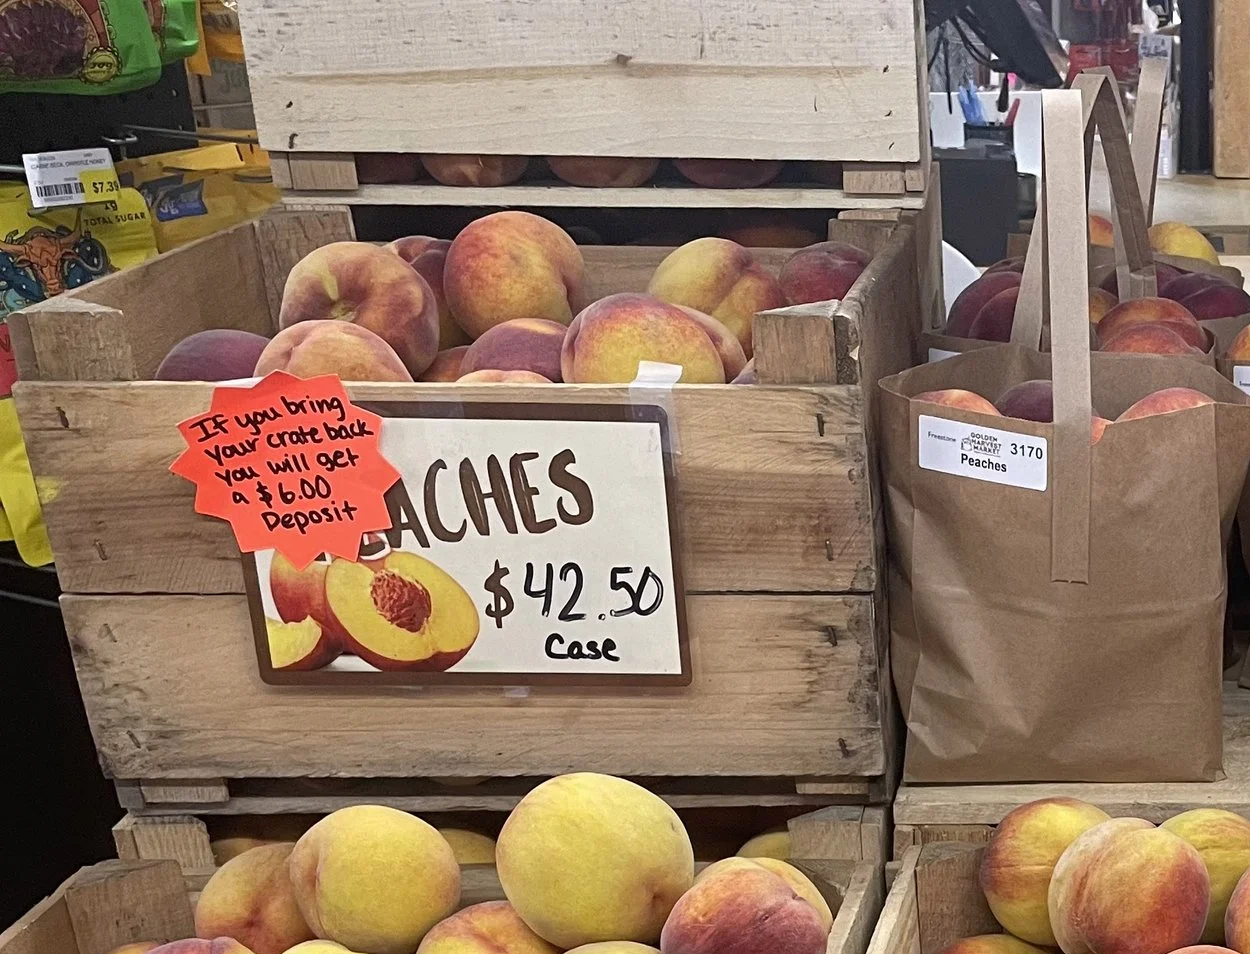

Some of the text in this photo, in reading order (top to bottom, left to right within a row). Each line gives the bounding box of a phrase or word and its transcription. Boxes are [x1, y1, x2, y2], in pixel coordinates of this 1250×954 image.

[92, 180, 119, 194] $7.39
[84, 211, 147, 226] TOTAL SUGAR
[189, 395, 346, 443] If you bring
[266, 425, 324, 449] crate
[323, 418, 374, 441] back
[970, 432, 998, 442] GOLDEN
[971, 438, 1002, 450] HARVEST
[973, 445, 1001, 455] MARKET
[1010, 443, 1043, 460] 3170
[214, 448, 360, 488] you will get
[961, 453, 1007, 473] Peaches
[232, 491, 250, 505] a
[358, 448, 595, 557] ACHES
[261, 501, 358, 534] Deposit
